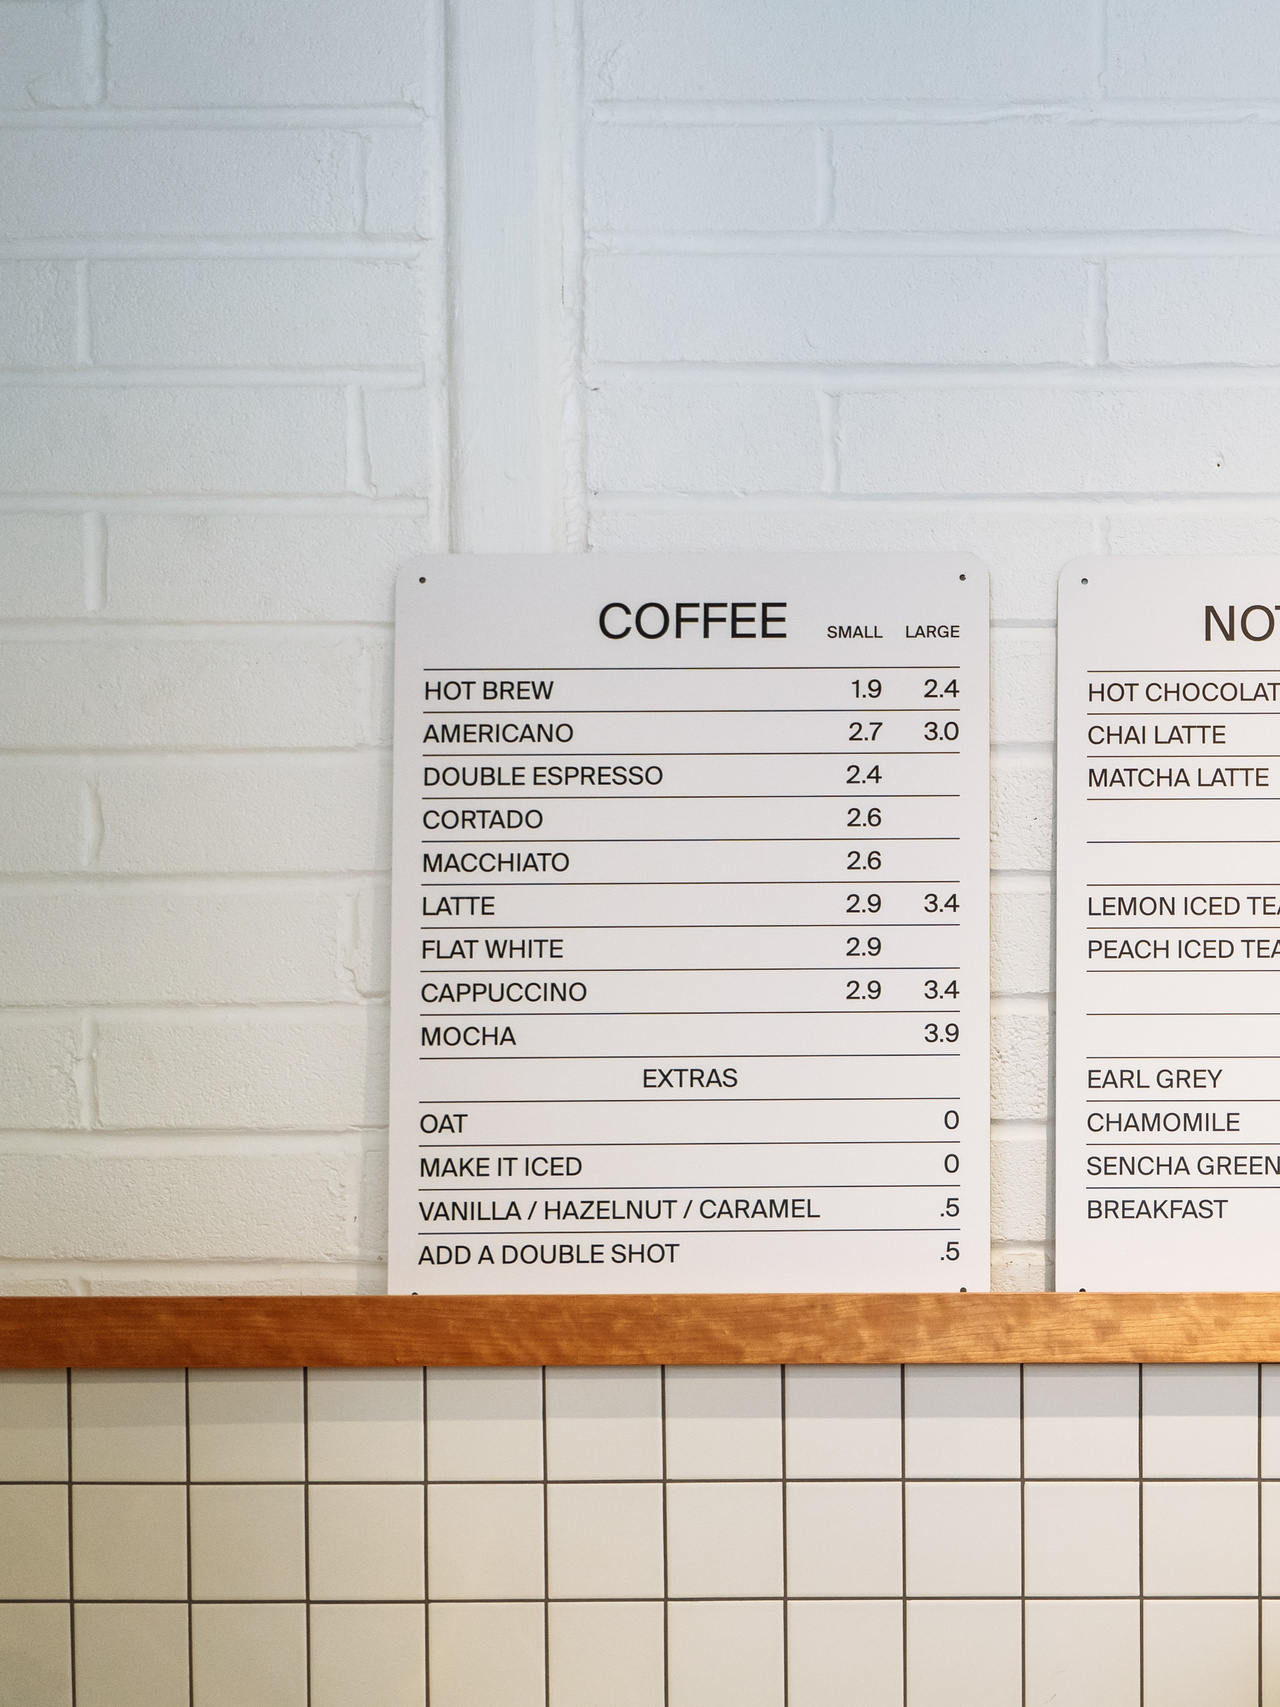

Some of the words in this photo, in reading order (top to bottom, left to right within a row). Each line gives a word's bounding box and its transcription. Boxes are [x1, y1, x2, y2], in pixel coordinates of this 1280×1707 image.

[598, 601, 788, 640] COFFEE
[826, 625, 884, 639] SMALL
[905, 624, 961, 639] LARGE
[424, 680, 477, 701] HOT
[482, 680, 555, 701] BREW
[851, 678, 883, 699] 1.9
[923, 678, 961, 699] 2.4
[1088, 682, 1140, 703] HOT
[422, 722, 574, 744] AMERICANO
[848, 721, 884, 742] 2.7
[923, 721, 960, 742] 3.0
[1087, 725, 1146, 746] CHAI
[1154, 724, 1227, 745] LATTE
[423, 766, 526, 787] DOUBLE
[532, 765, 664, 786] ESPRESSO
[845, 764, 883, 785] 2.4
[1088, 767, 1191, 788] MATCHA
[1197, 767, 1270, 787] LATTE
[422, 809, 544, 830] CORTADO
[846, 807, 882, 828] 2.6
[422, 851, 570, 873] MACCHIATO
[846, 850, 882, 871] 2.6
[422, 895, 496, 917] LATTE
[845, 893, 882, 914] 2.9
[923, 892, 961, 914] 3.4
[1088, 896, 1176, 917] LEMON
[1183, 895, 1241, 916] ICED
[422, 939, 480, 960] FLAT
[484, 938, 564, 959] WHITE
[845, 936, 882, 957] 2.9
[1088, 939, 1170, 960] PEACH
[1178, 939, 1235, 959] ICED
[420, 981, 588, 1004] CAPPUCCINO
[845, 979, 882, 1000] 2.9
[923, 979, 961, 1000] 3.4
[421, 1025, 517, 1047] MOCHA
[924, 1022, 960, 1044] 3.9
[643, 1067, 738, 1089] EXTRAS
[1087, 1069, 1151, 1089] EARL
[1156, 1068, 1223, 1089] GREY
[419, 1113, 469, 1134] OAT
[943, 1109, 960, 1130] 0
[1086, 1112, 1241, 1133] CHAMOMILE
[420, 1157, 491, 1178] MAKE
[497, 1156, 519, 1177] IT
[524, 1156, 583, 1177] ICED
[943, 1153, 960, 1174] 0
[1086, 1155, 1191, 1176] SENCHA
[1196, 1155, 1280, 1176] GREEN
[418, 1200, 523, 1222] VANILLA
[544, 1199, 678, 1221] HAZELNUT
[699, 1198, 821, 1220] CARAMEL
[940, 1197, 960, 1218] .5
[1087, 1198, 1229, 1220] BREAKFAST
[417, 1244, 472, 1266] ADD
[477, 1244, 496, 1265] A
[501, 1243, 605, 1265] DOUBLE
[610, 1243, 681, 1264] SHOT
[940, 1241, 960, 1262] .5
